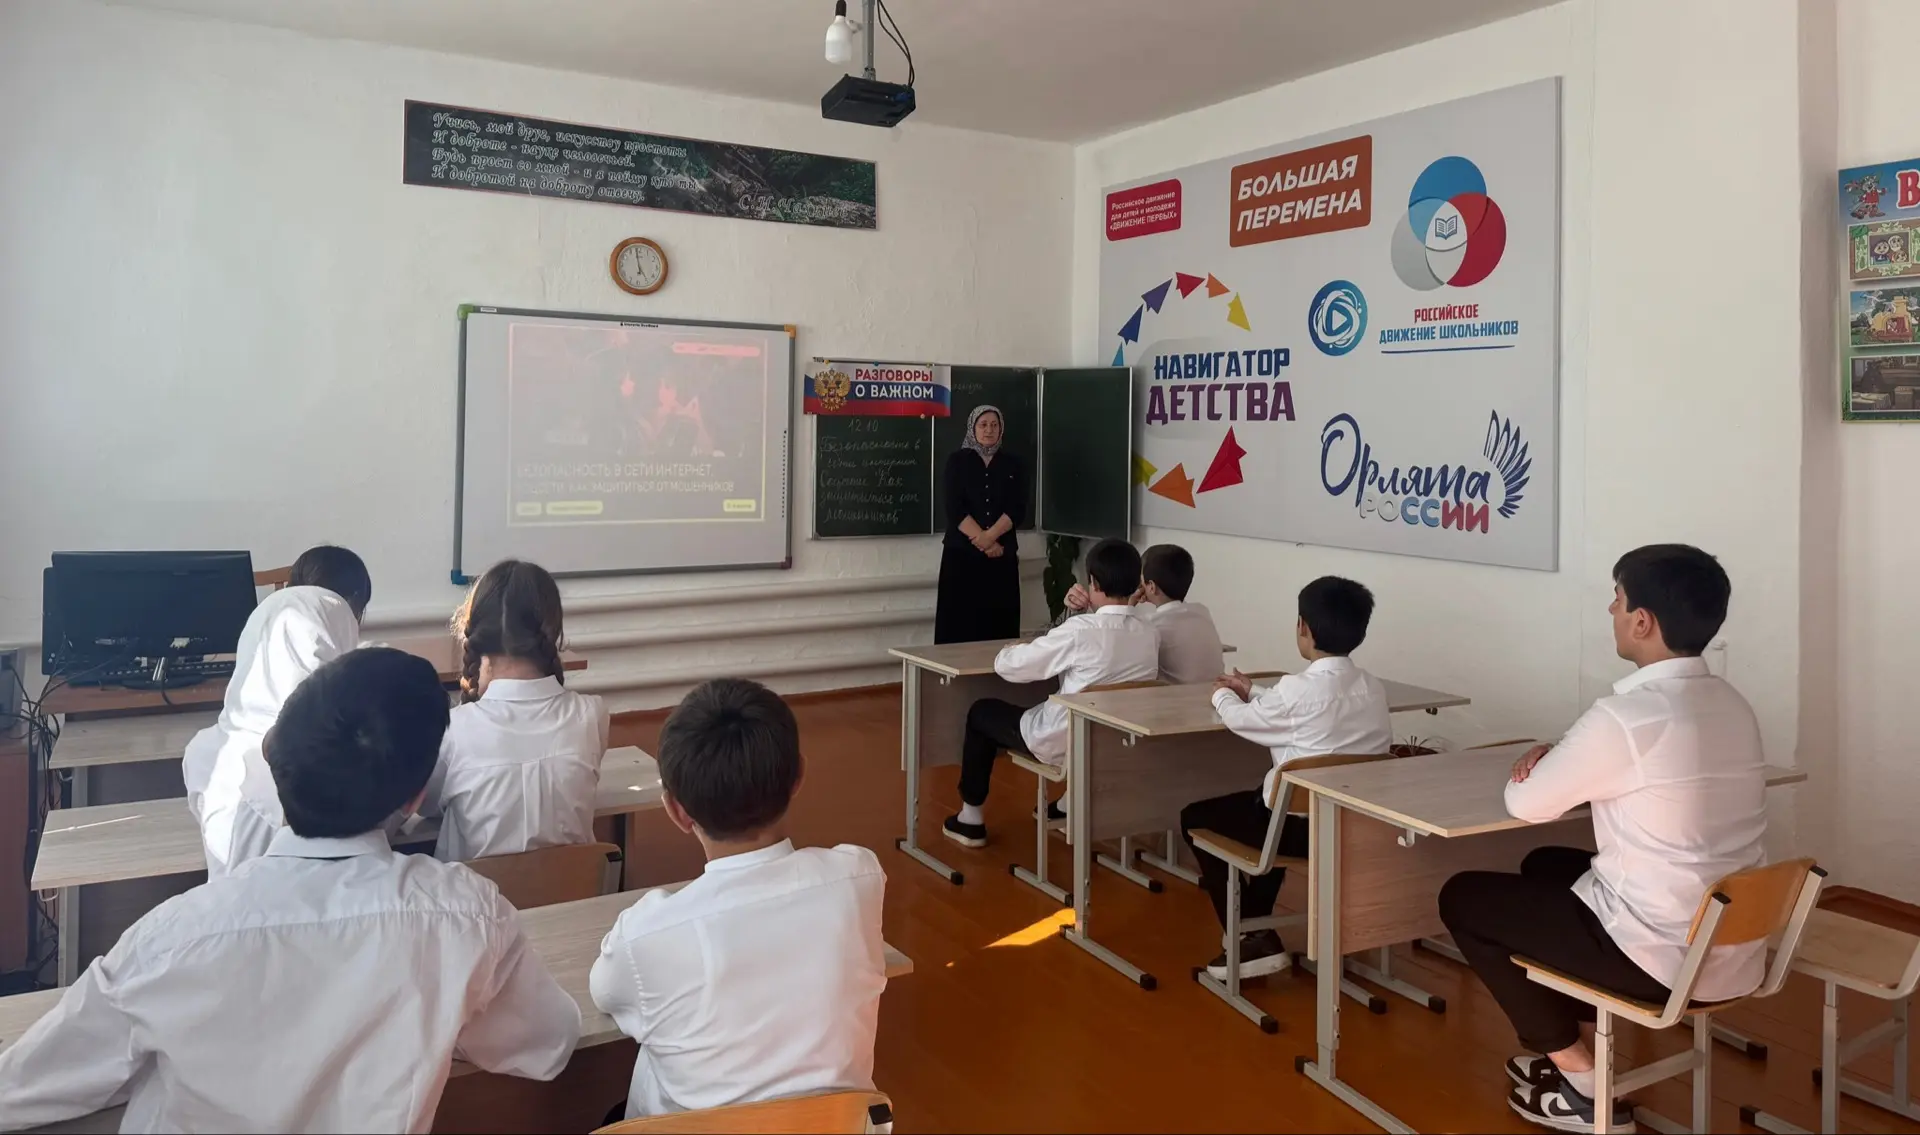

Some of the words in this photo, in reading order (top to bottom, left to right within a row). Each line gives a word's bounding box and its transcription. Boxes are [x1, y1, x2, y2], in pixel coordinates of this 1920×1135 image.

[432, 112, 481, 133] Учись,
[486, 122, 514, 135] мой
[517, 121, 550, 142] друг,
[556, 131, 621, 152] искусству
[624, 140, 687, 158] простоты
[432, 130, 448, 144] И
[450, 130, 507, 152] доброте
[521, 144, 559, 160] науке
[563, 148, 636, 167] человечьей.
[431, 147, 467, 165] Будь
[471, 154, 513, 170] прост
[516, 160, 532, 172] со
[534, 162, 570, 177] мной
[583, 168, 592, 178] и
[595, 170, 604, 180] я
[607, 171, 648, 188] пойму
[651, 175, 675, 189] кто
[431, 164, 448, 179] И
[449, 165, 516, 187] добротой
[520, 177, 536, 188] на
[540, 175, 595, 198] доброту
[597, 186, 645, 204] отвечу.
[1237, 154, 1358, 201] БОЛЬШАЯ
[1111, 198, 1145, 211] Российское
[1145, 192, 1176, 205] движение
[1111, 213, 1122, 222] для
[1122, 208, 1139, 219] детей
[1145, 202, 1176, 213] молодежи
[1237, 188, 1362, 232] ПЕРЕМЕНА
[1109, 216, 1146, 231] «ДВИЖЕНИЕ
[1146, 211, 1177, 223] ПЕРВЫХ»
[1414, 304, 1479, 323] РОССИЙСКОЕ
[1379, 326, 1436, 344] ДВИЖЕНИЕ
[1439, 320, 1519, 339] ШКОЛЬНИКОВ
[855, 368, 933, 382] РАЗГОВОРЫ
[1154, 348, 1290, 381] НАВИГАТОР
[855, 384, 866, 397] О
[870, 384, 934, 399] ВАЖНОМ
[1146, 381, 1296, 426] ДЕТСТВА
[614, 463, 622, 477] В
[624, 463, 653, 477] СЕТИ
[1320, 412, 1491, 508] Орлята
[657, 481, 669, 492] ОТ
[1359, 491, 1490, 535] РОССИИ
